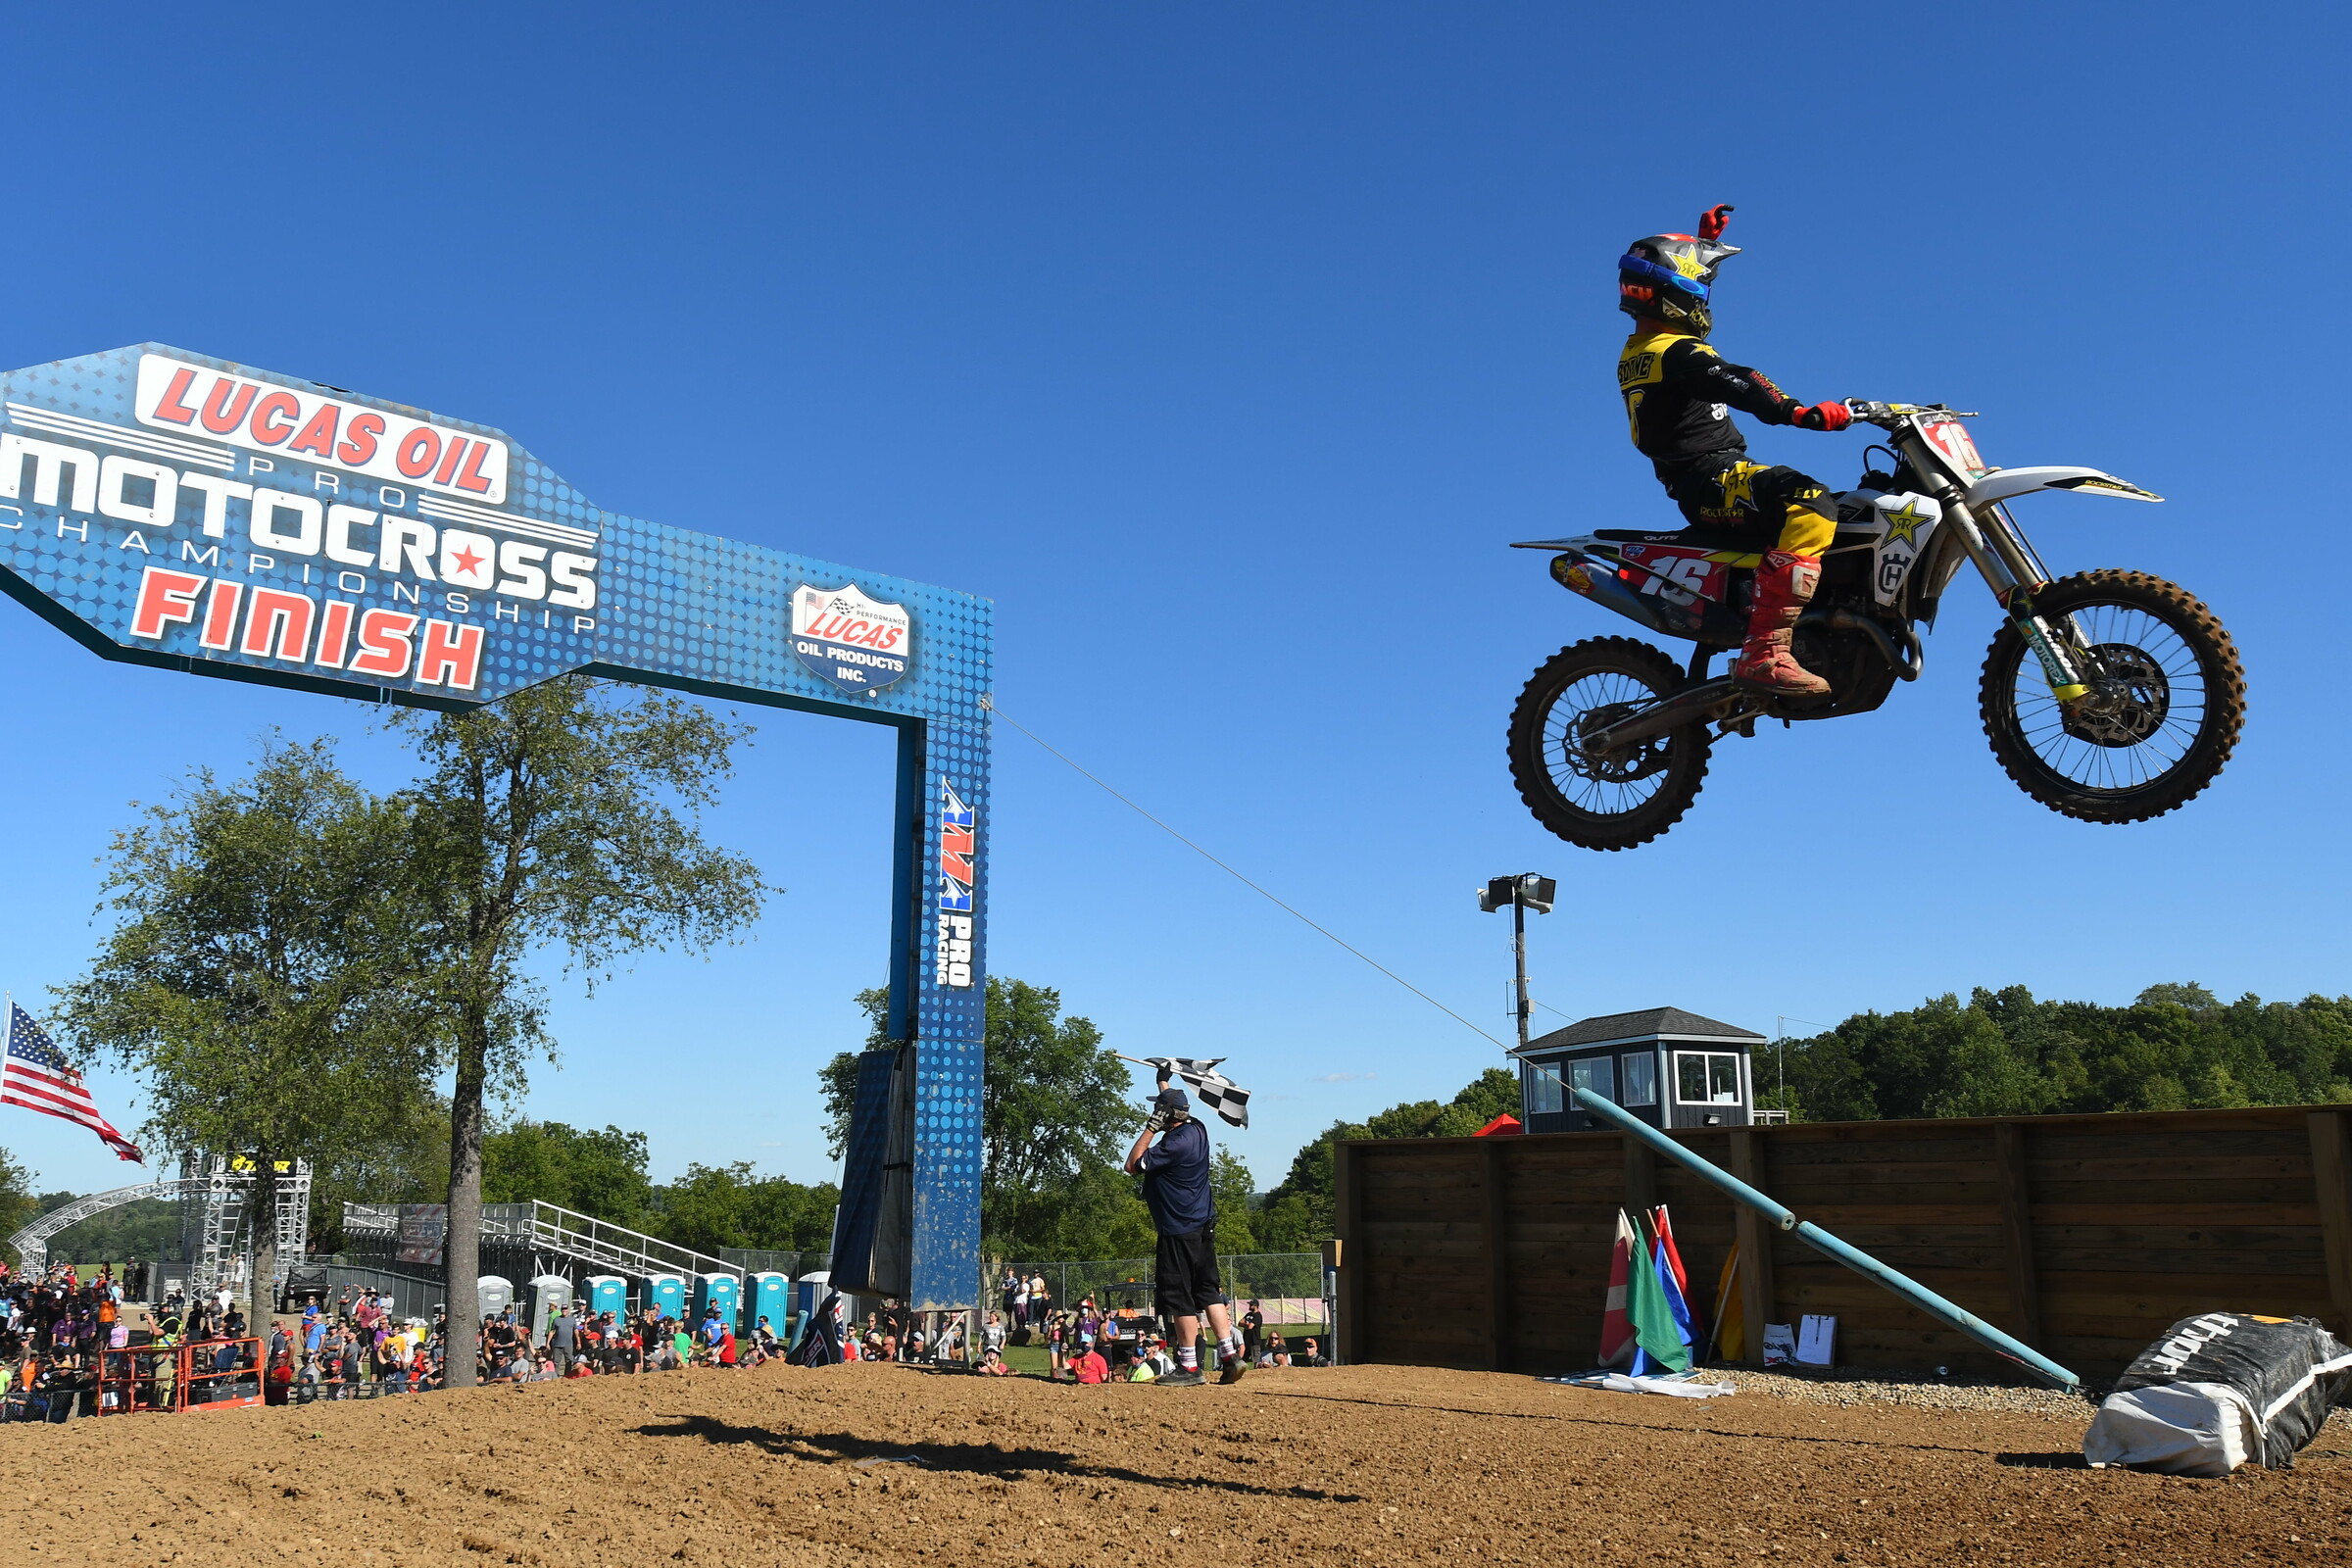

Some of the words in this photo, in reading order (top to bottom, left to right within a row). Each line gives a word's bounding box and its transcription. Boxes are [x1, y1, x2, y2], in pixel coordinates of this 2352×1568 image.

[153, 368, 386, 466] LUCAS
[396, 425, 493, 493] OIL
[1935, 422, 1984, 471] 16
[248, 456, 408, 510] PRO
[1792, 486, 1823, 500] FLY
[0, 431, 598, 610] MOTOCROSS
[0, 504, 596, 635] CHAMPIONSHIP
[1640, 555, 1712, 607] 16
[129, 564, 486, 691] FINISH
[805, 612, 903, 650] LUCAS
[856, 610, 906, 626] PERFORMANCE
[797, 641, 823, 658] OIL
[826, 646, 905, 672] PRODUCTS
[837, 666, 867, 683] INC.
[2029, 633, 2066, 684] MOTOREX
[939, 775, 975, 912] AMA
[936, 913, 950, 986] RACING
[948, 914, 972, 987] PRO
